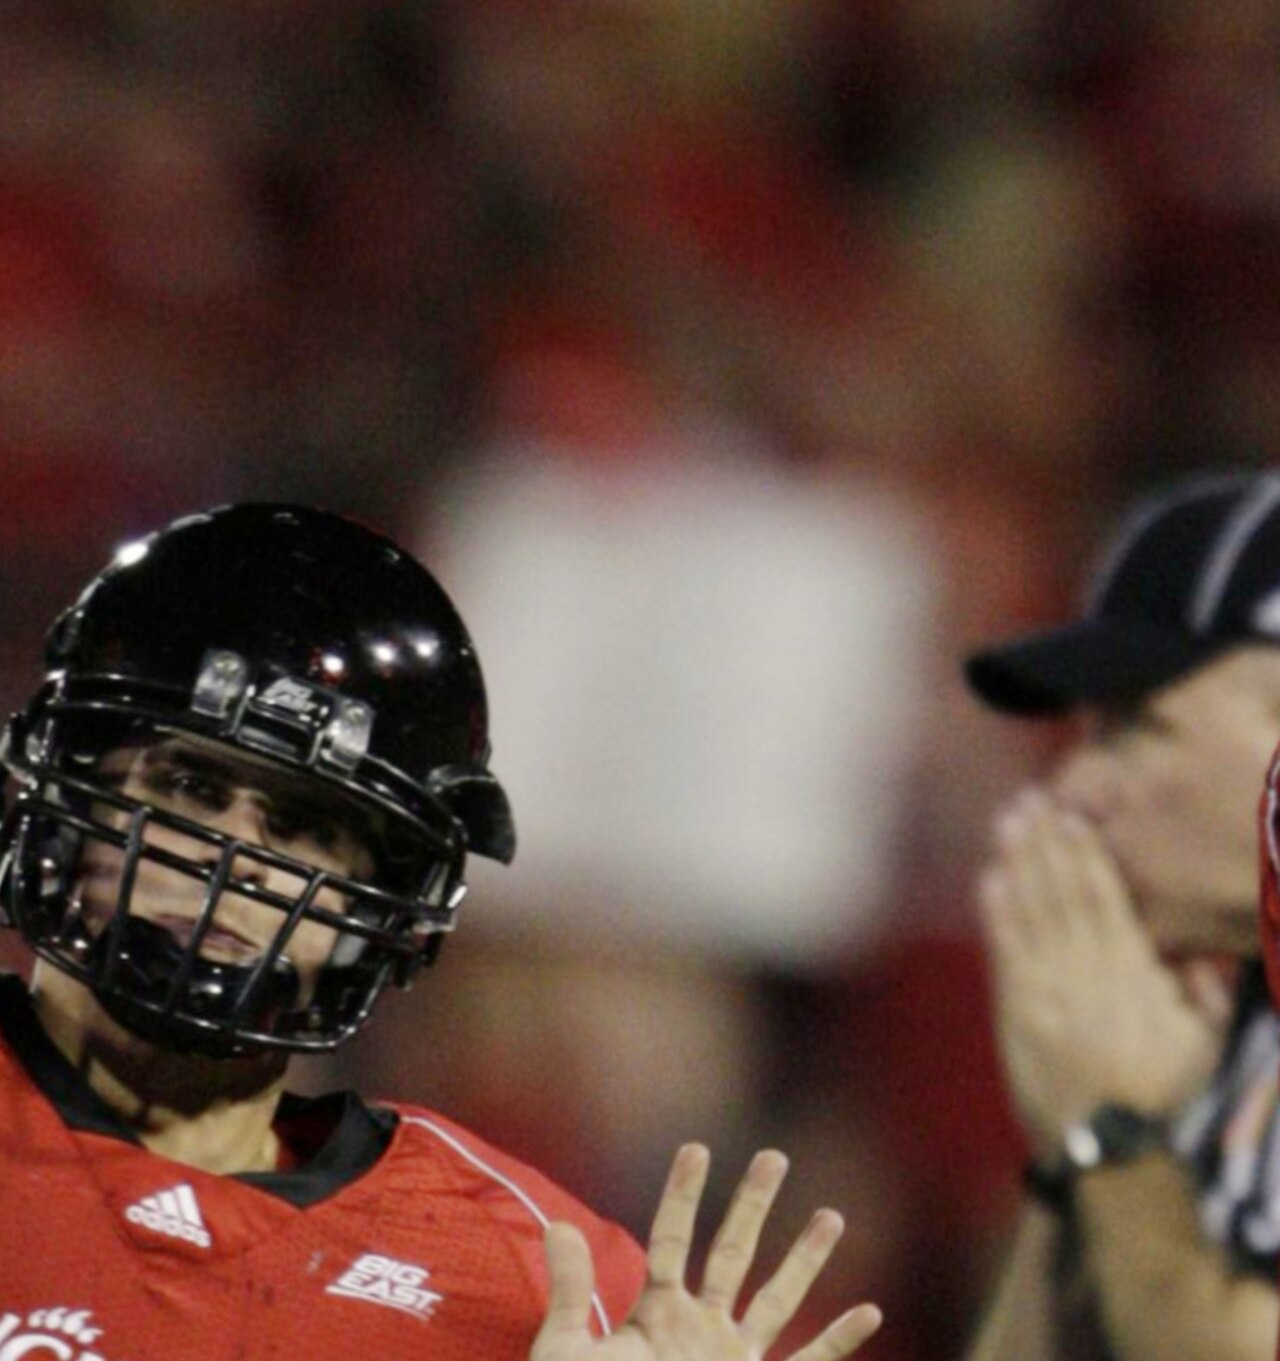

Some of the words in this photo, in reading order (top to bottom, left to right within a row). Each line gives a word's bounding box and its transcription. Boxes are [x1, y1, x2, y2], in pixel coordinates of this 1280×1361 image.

[124, 1204, 212, 1249] adidas
[336, 1269, 444, 1311] EAST
[351, 1253, 430, 1286] BIG
